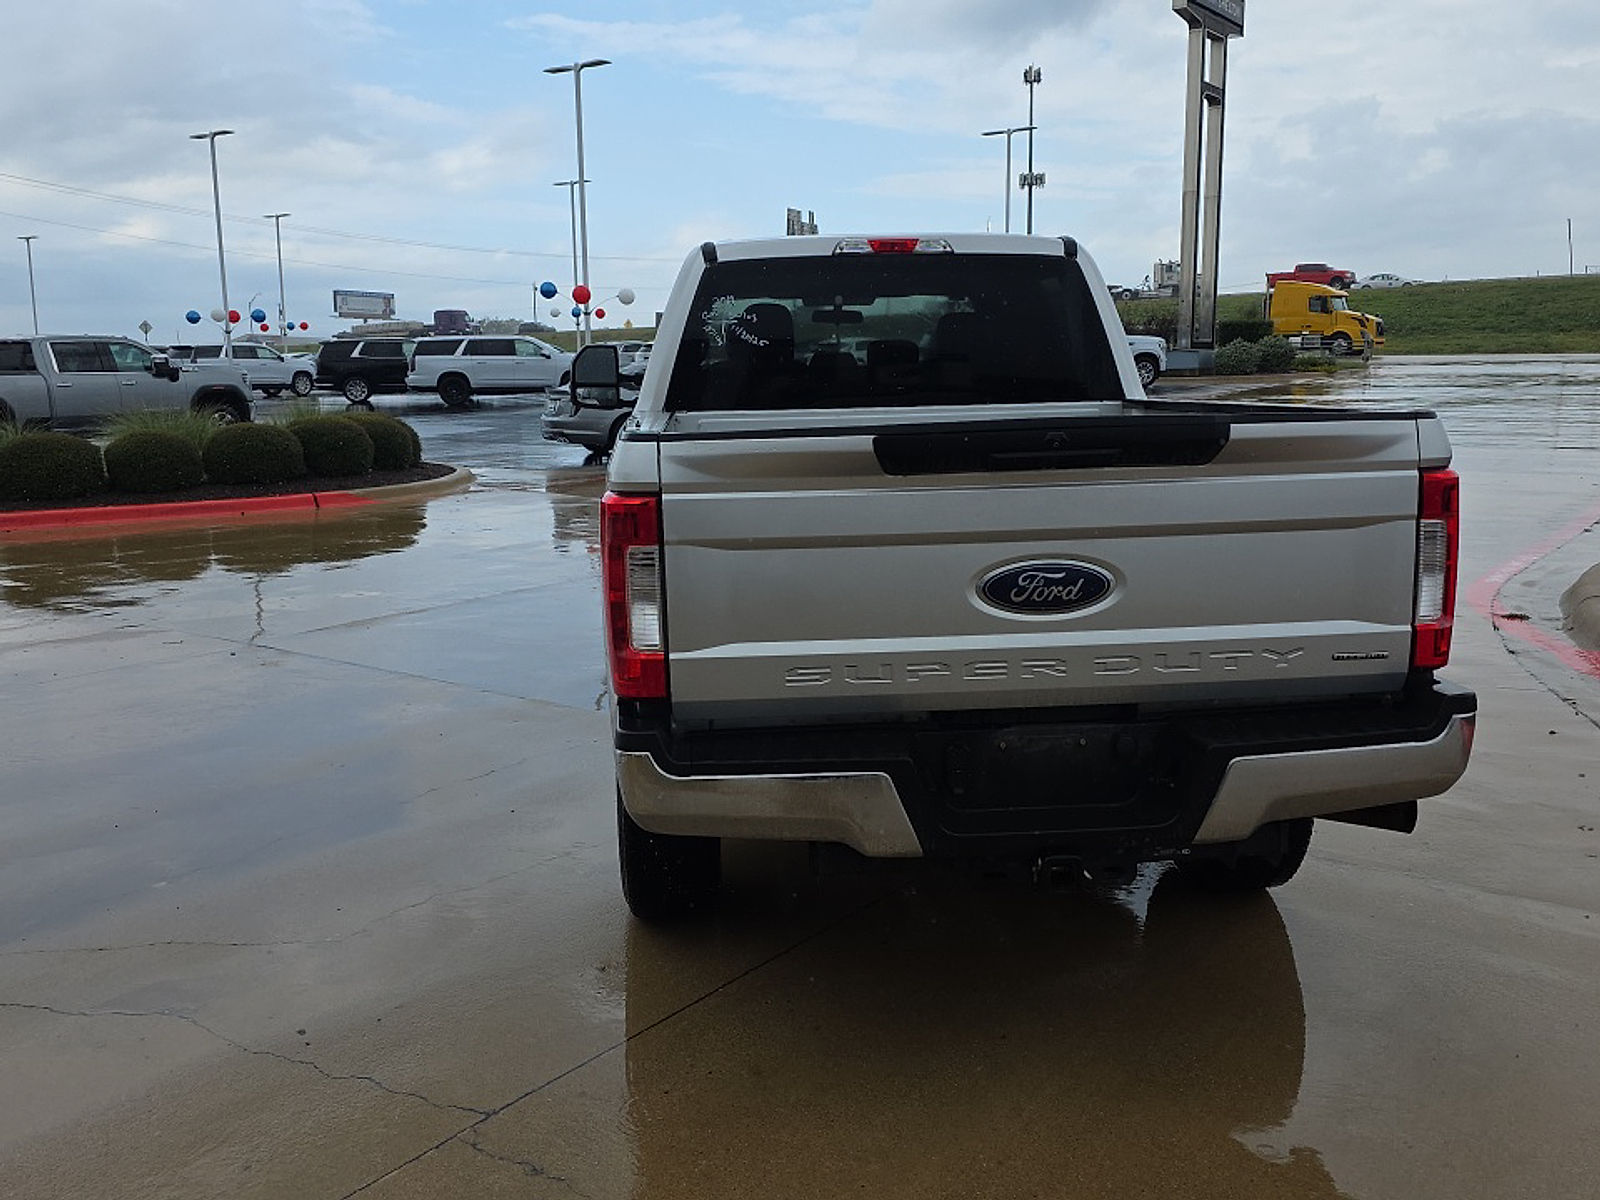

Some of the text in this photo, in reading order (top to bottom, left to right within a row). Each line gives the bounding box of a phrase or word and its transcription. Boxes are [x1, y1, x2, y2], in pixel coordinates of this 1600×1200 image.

[1010, 571, 1085, 602] Ford
[784, 647, 1304, 687] SUPER DUTY
